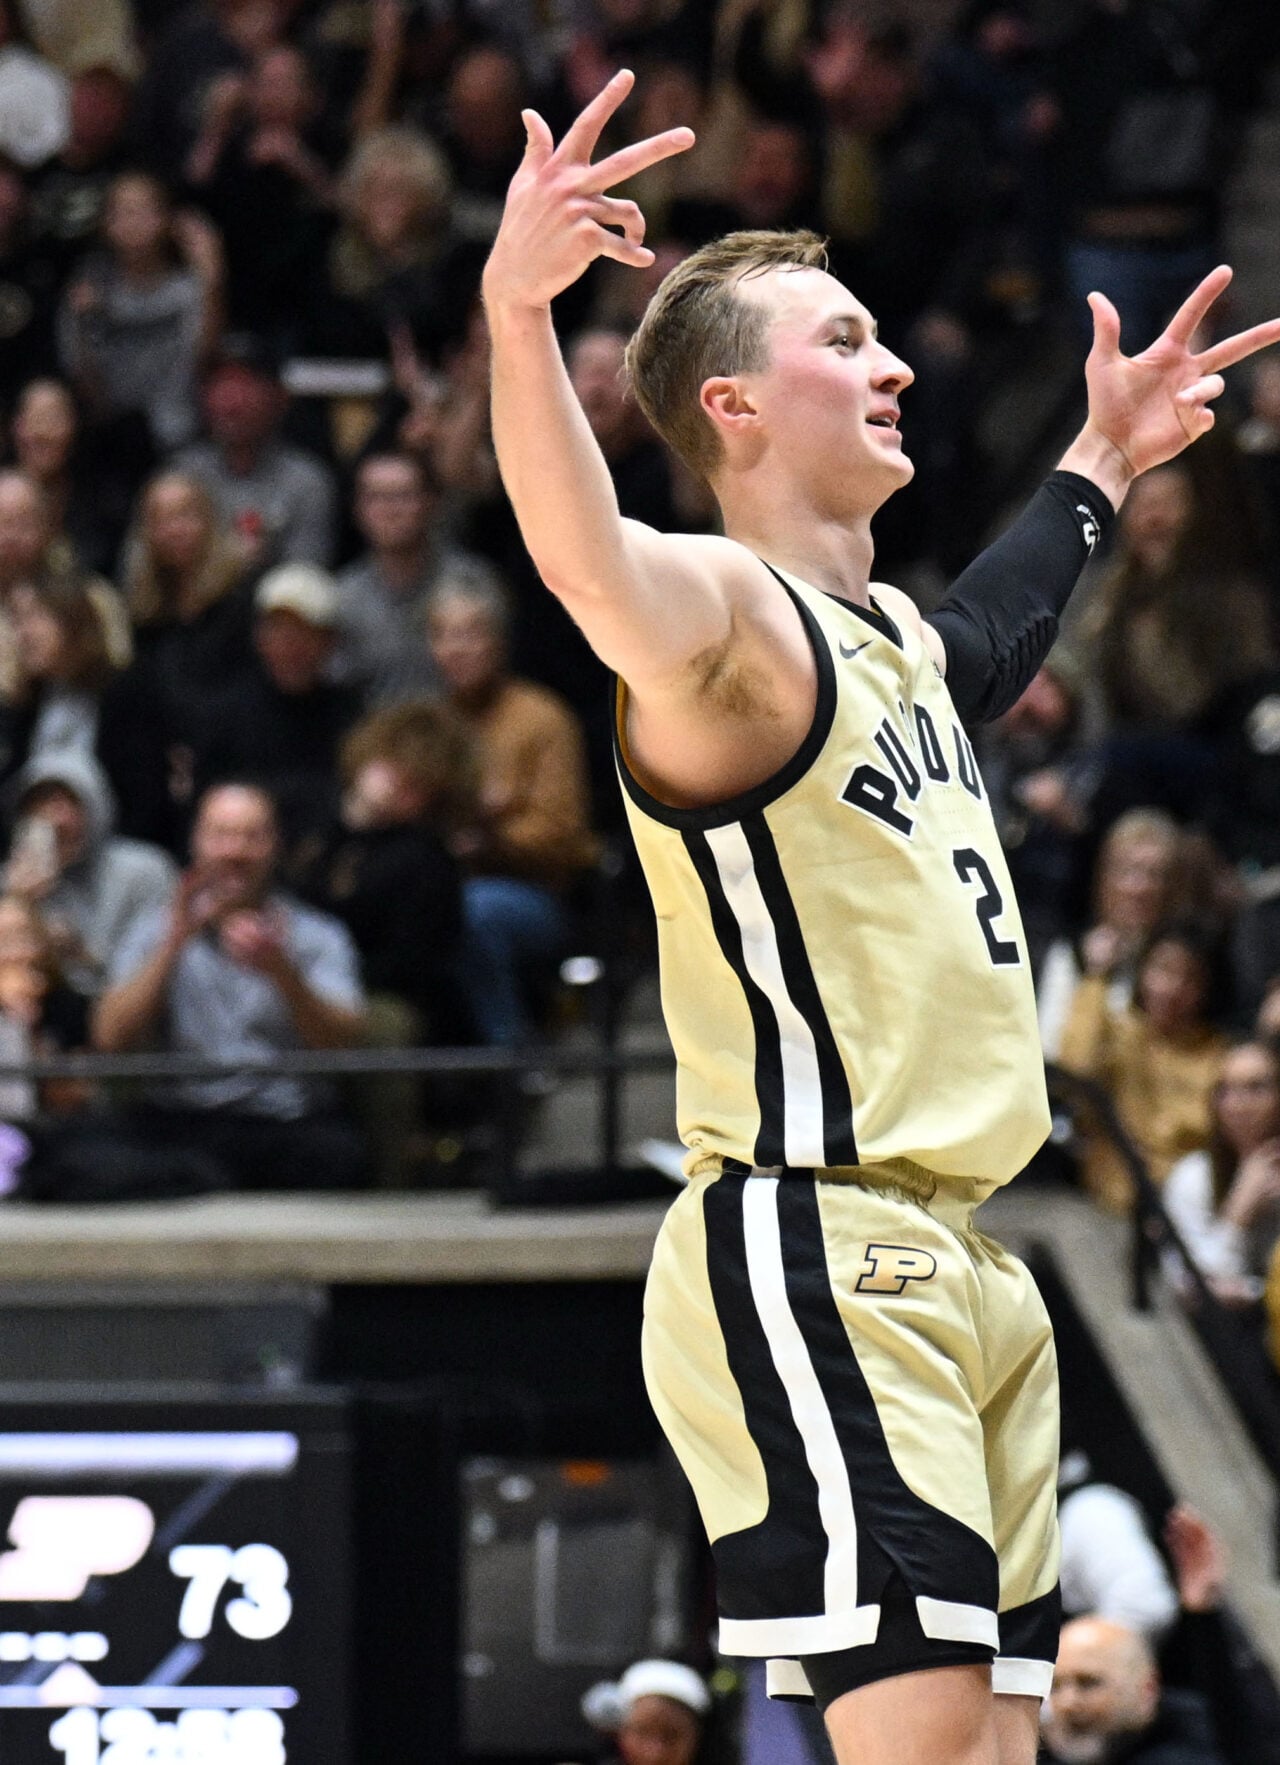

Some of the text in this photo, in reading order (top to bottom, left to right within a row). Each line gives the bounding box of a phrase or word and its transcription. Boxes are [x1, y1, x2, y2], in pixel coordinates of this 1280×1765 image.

[838, 697, 986, 842] PUDU
[951, 846, 1022, 967] 2
[854, 1243, 937, 1295] P
[169, 1543, 292, 1640] 73
